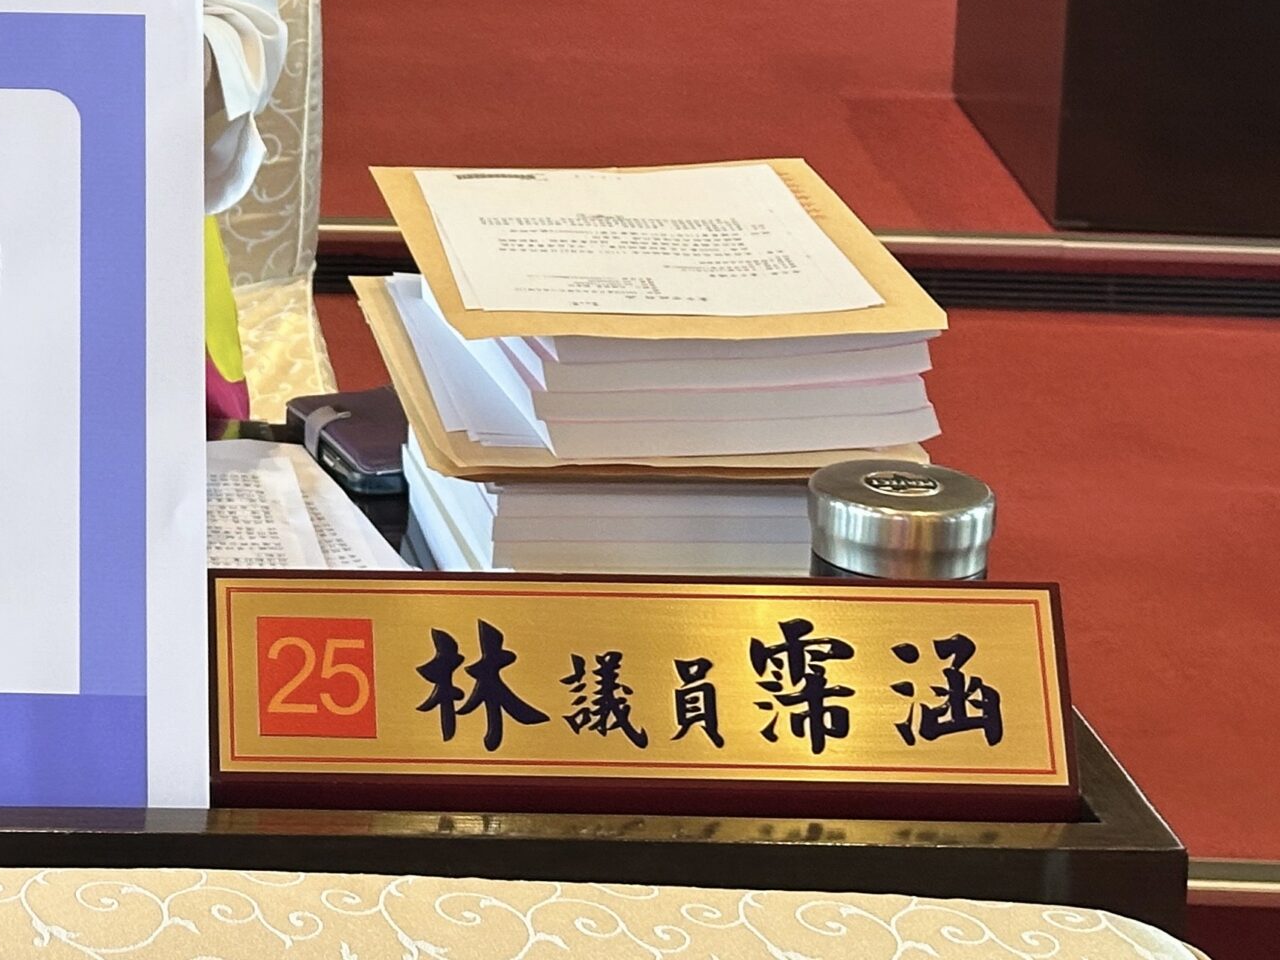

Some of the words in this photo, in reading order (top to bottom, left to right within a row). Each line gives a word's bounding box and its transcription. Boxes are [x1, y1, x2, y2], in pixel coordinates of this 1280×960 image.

[267, 635, 371, 719] 25
[415, 618, 1005, 756] 林議員霈涵
